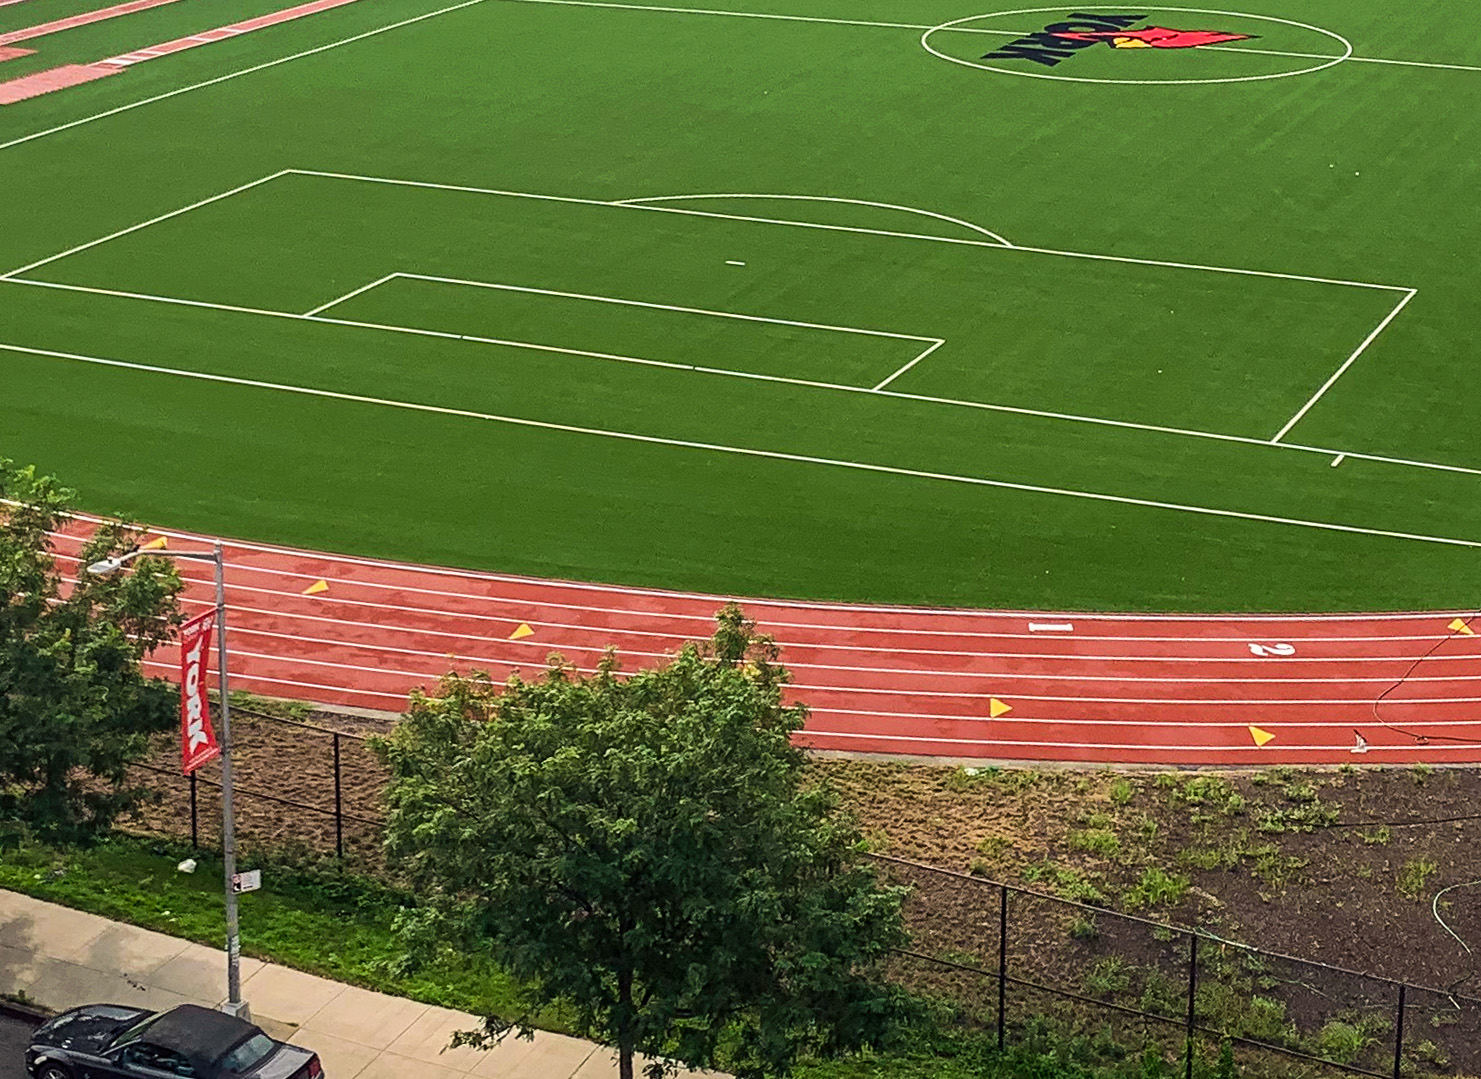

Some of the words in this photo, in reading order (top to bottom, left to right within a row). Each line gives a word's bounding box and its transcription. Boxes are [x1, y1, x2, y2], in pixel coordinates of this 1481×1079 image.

[1028, 622, 1074, 632] 1
[1248, 643, 1296, 656] 2
[186, 634, 209, 756] YORK
